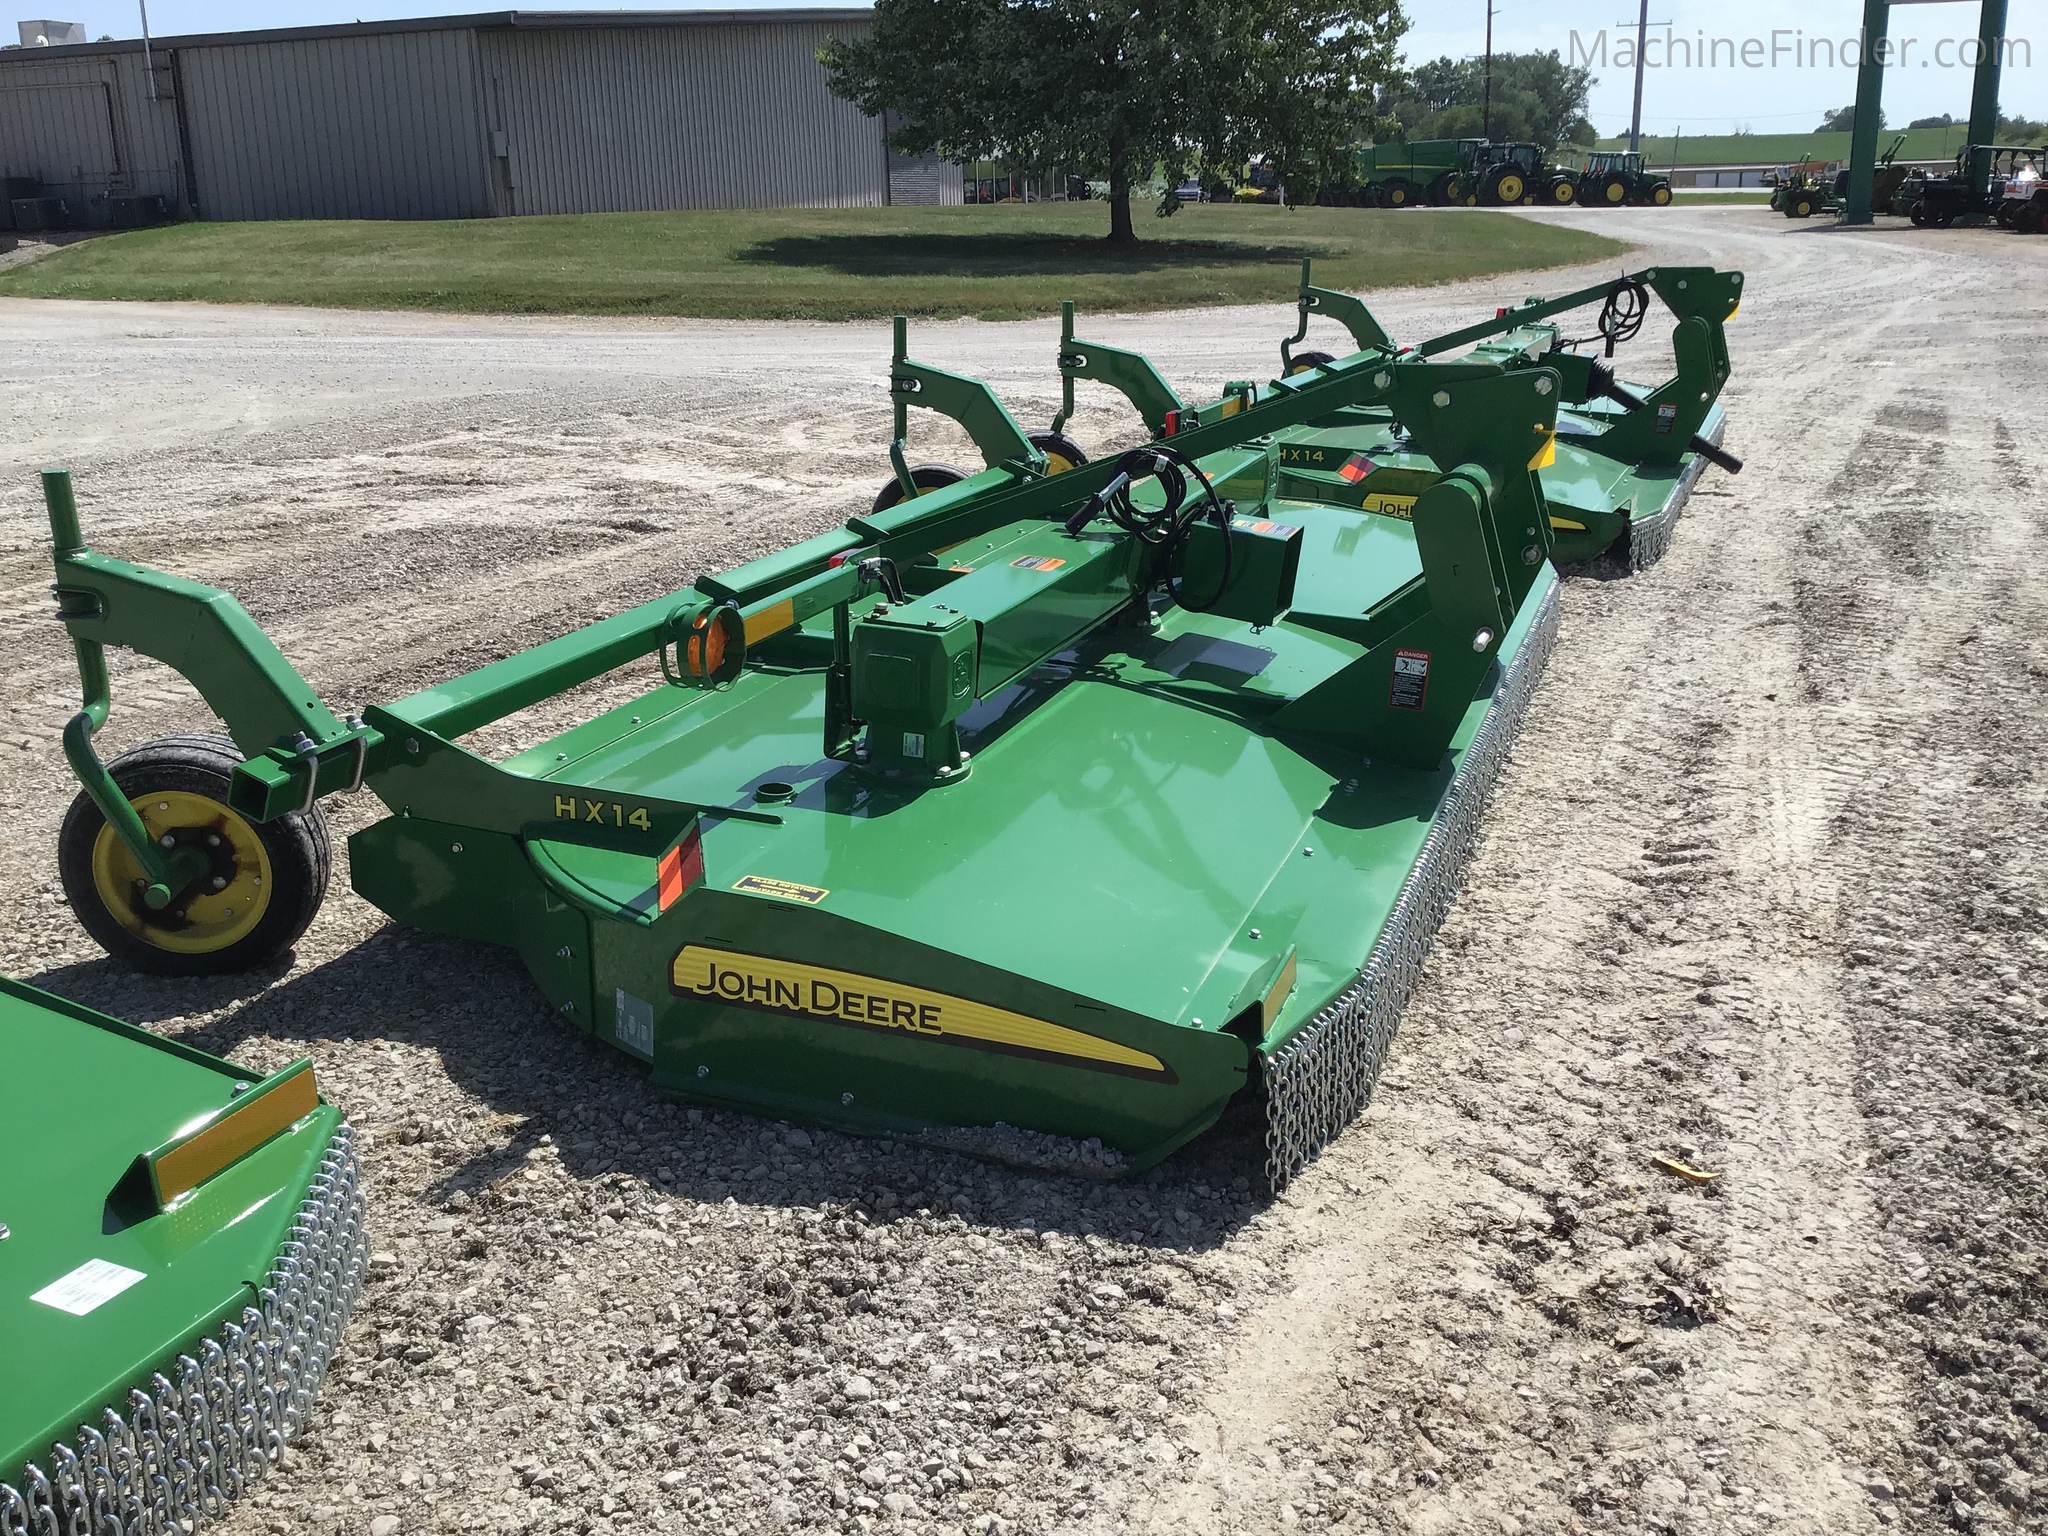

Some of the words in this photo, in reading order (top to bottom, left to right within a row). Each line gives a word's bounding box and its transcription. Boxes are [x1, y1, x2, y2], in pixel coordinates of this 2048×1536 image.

[1378, 500, 1413, 516] JOH
[1404, 651, 1428, 659] DANGER
[555, 795, 652, 831] HX14
[778, 882, 819, 894] ROTATION
[696, 962, 800, 1007] JOHN
[811, 980, 942, 1032] DEERE
